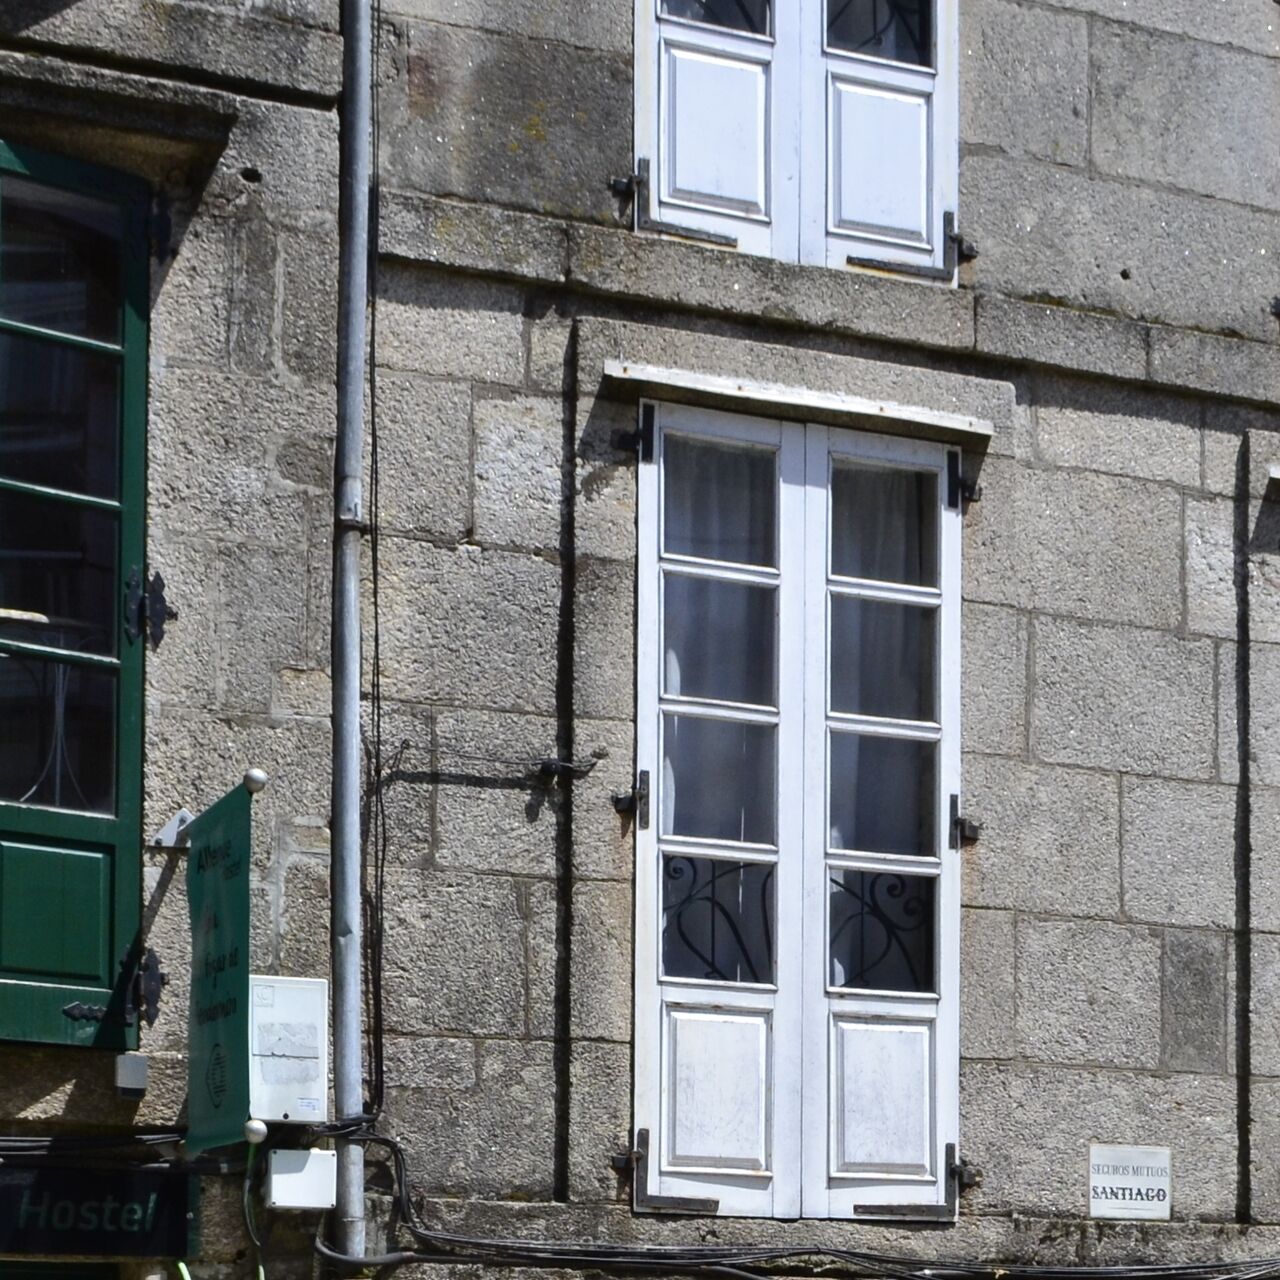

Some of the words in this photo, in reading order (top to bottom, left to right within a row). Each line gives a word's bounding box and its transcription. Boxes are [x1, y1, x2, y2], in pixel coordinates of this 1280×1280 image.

[1091, 1163, 1130, 1177] SEGUROS
[1131, 1165, 1169, 1178] MUTUOS
[1091, 1185, 1168, 1202] SANTIAGO
[15, 1189, 159, 1233] Hostel
